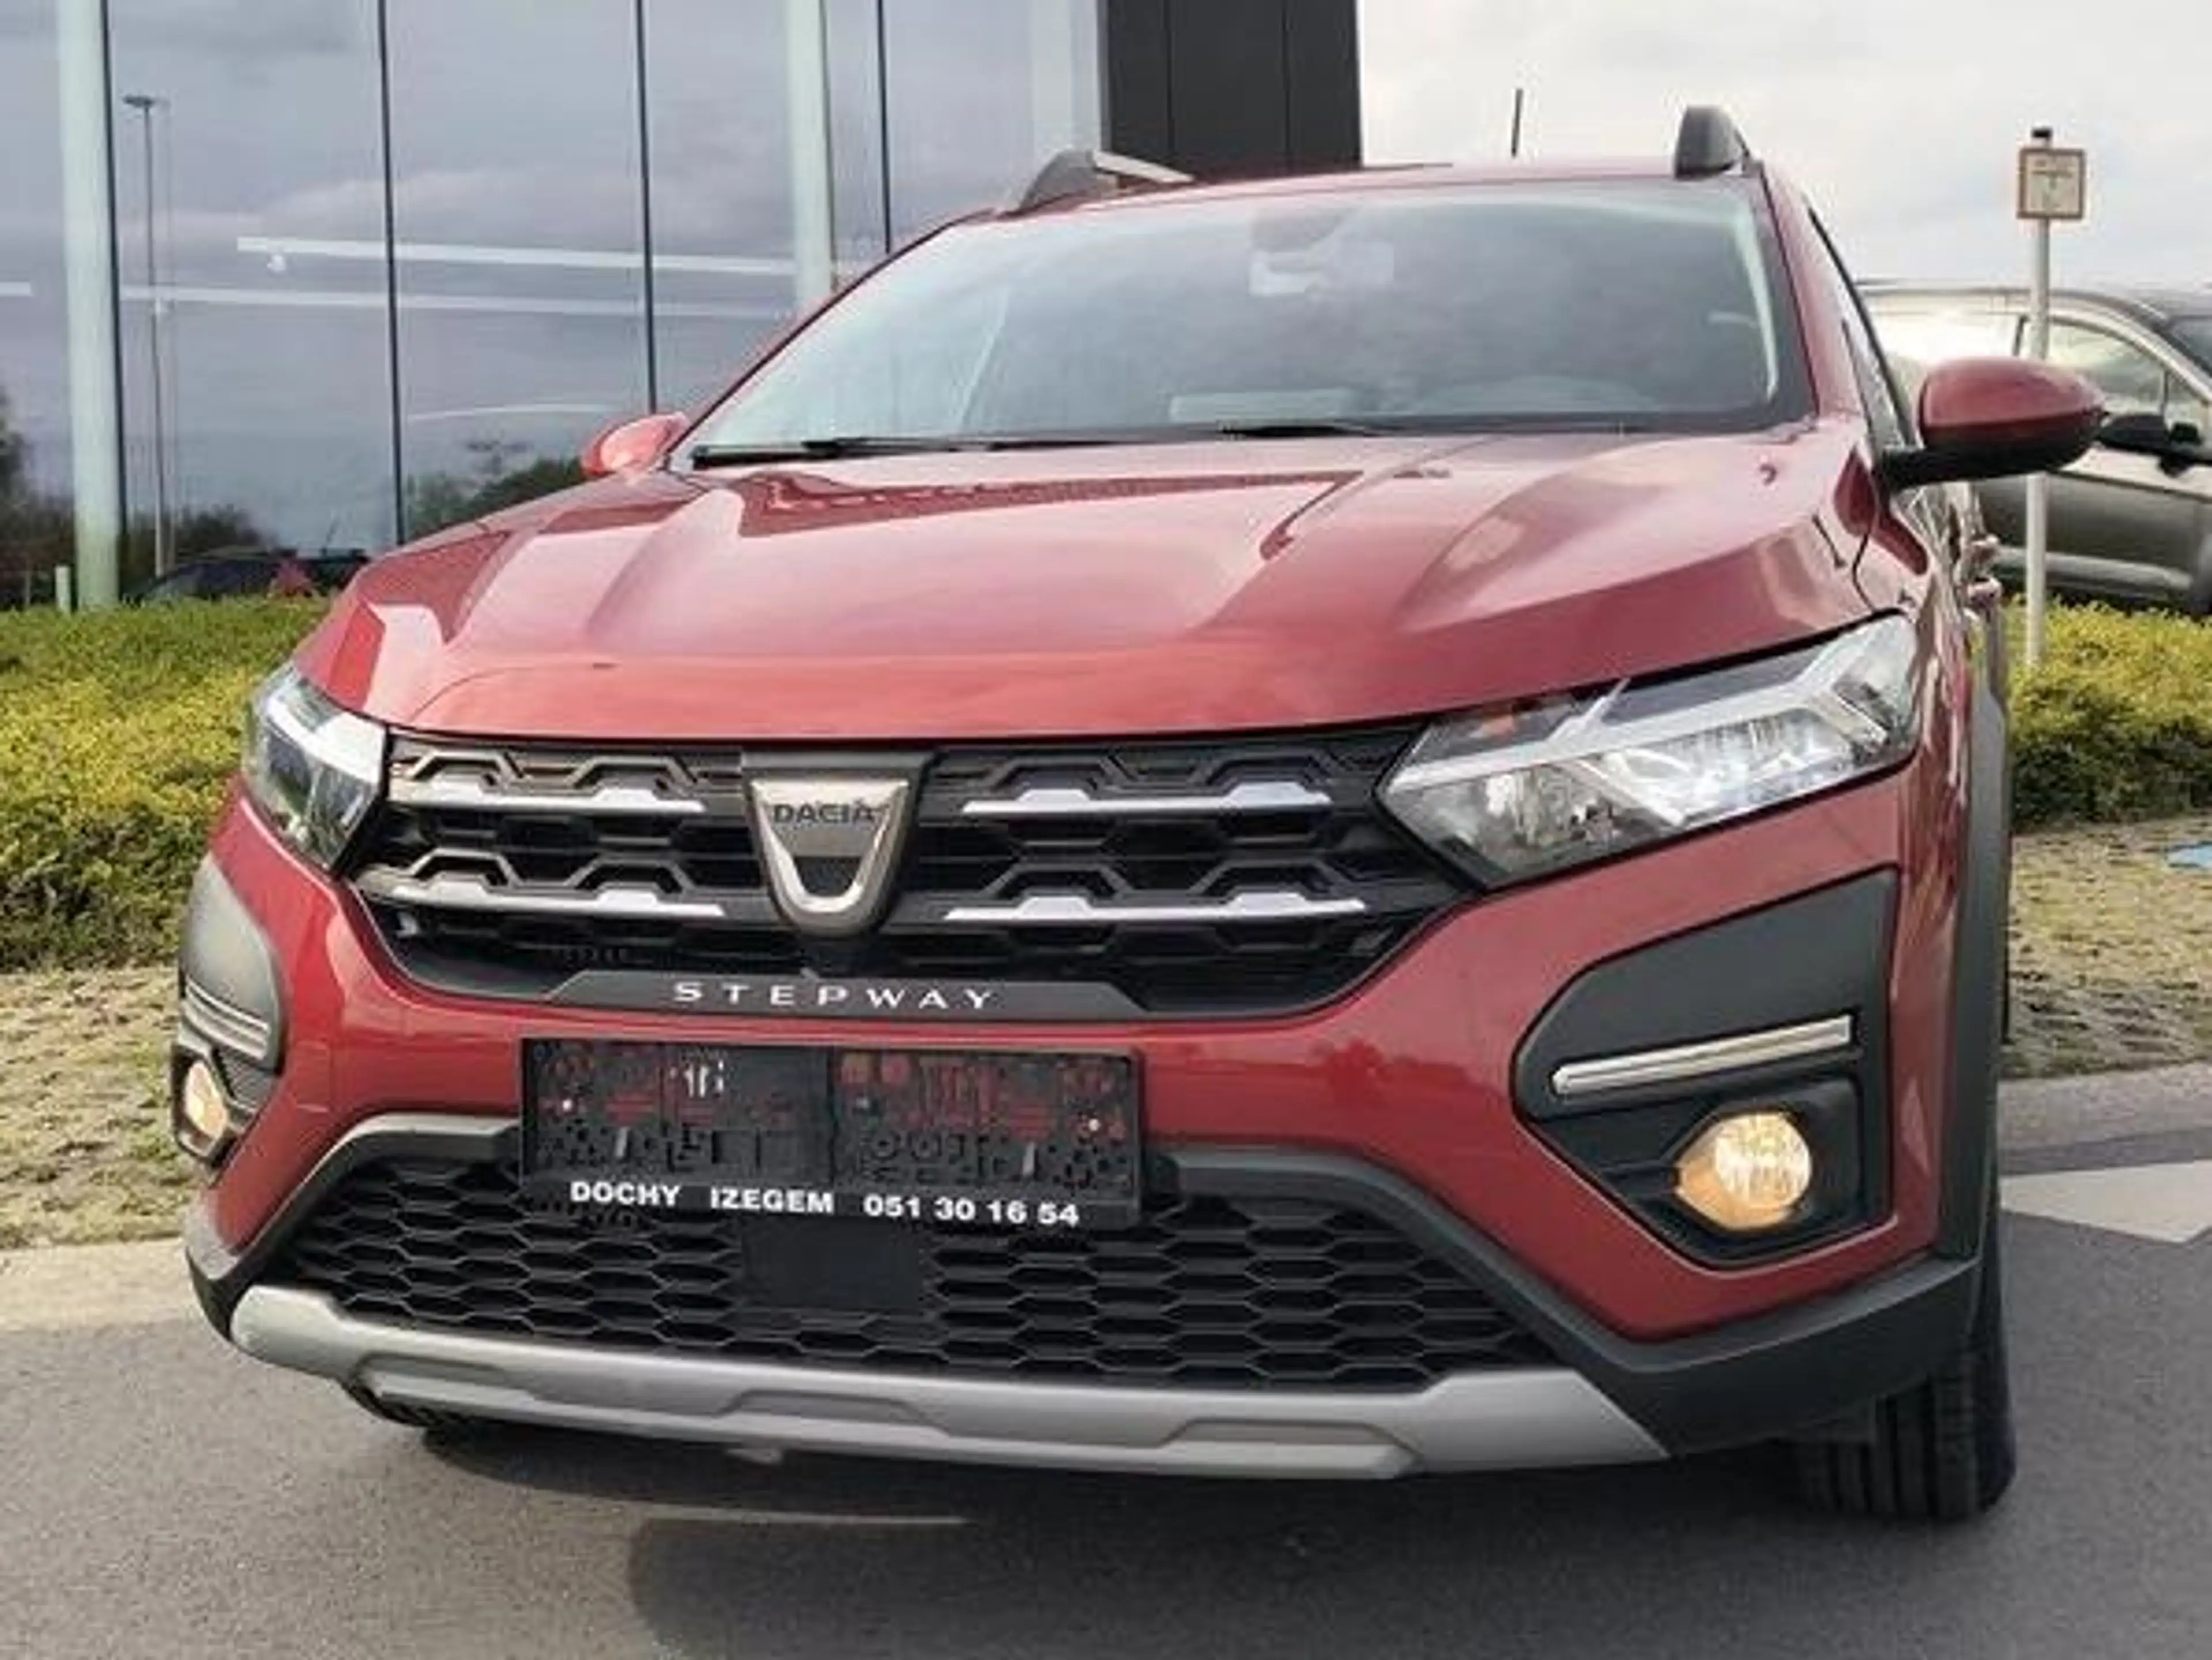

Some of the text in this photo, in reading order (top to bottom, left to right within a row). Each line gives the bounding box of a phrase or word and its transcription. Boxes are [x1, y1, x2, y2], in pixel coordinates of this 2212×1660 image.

[774, 802, 876, 823] DACIA
[673, 982, 992, 1009] STEPWAY
[571, 1180, 1080, 1227] DOCHY IZEGEM 051 30 16 54
